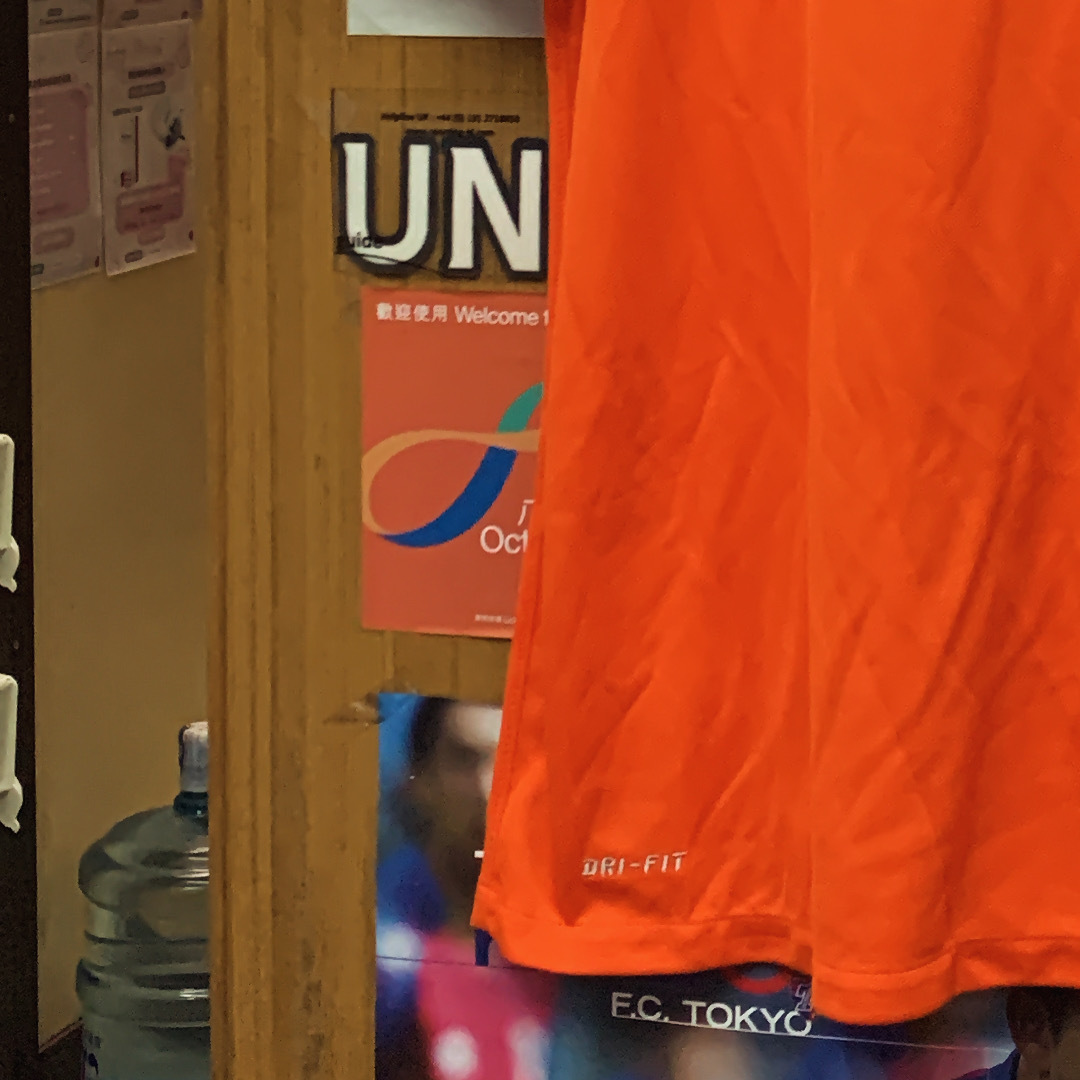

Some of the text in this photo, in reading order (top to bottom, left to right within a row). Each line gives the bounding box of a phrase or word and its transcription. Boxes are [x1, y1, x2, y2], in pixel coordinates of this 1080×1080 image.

[454, 305, 539, 326] Welcome
[582, 851, 688, 877] DRI-FIT
[682, 1000, 813, 1037] TOKYO
